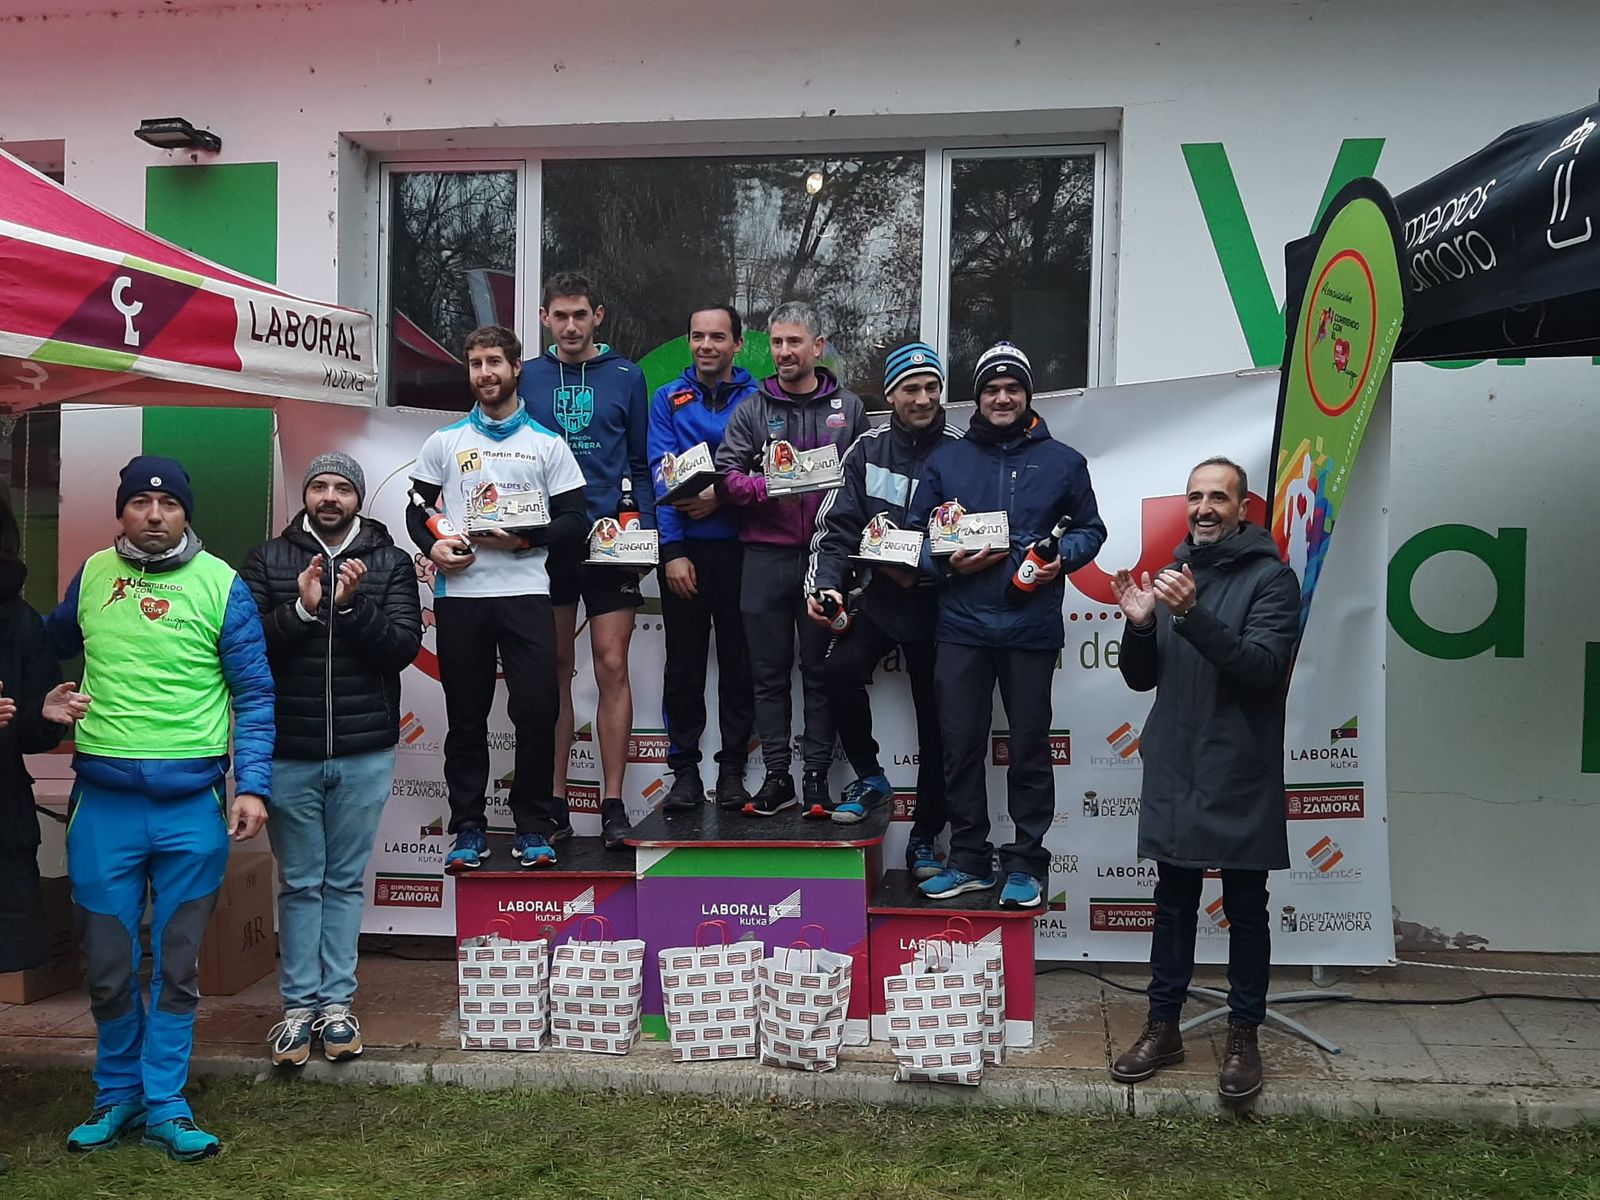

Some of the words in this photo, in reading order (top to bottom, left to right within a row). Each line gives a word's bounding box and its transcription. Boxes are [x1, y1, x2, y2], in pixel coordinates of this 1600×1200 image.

[248, 300, 361, 361] LABORAL
[1022, 564, 1034, 579] 3
[1290, 747, 1359, 761] LABORAL
[1330, 760, 1359, 769] kutxa
[392, 785, 405, 796] DE
[407, 786, 448, 798] ZAMORA
[1101, 805, 1117, 817] DE
[1303, 802, 1361, 815] ZAMORA
[384, 842, 444, 855] LABORAL
[417, 855, 444, 864] kutxa
[390, 891, 440, 902] ZAMORA
[497, 900, 562, 912] LABORAL
[701, 903, 767, 916] LABORAL
[535, 912, 563, 923] kutxa
[739, 915, 768, 927] kutxa
[1299, 911, 1373, 922] AYUNTAMIENTO
[1299, 920, 1315, 933] DE
[1318, 919, 1373, 933] ZAMORA
[1040, 930, 1068, 939] kutxa
